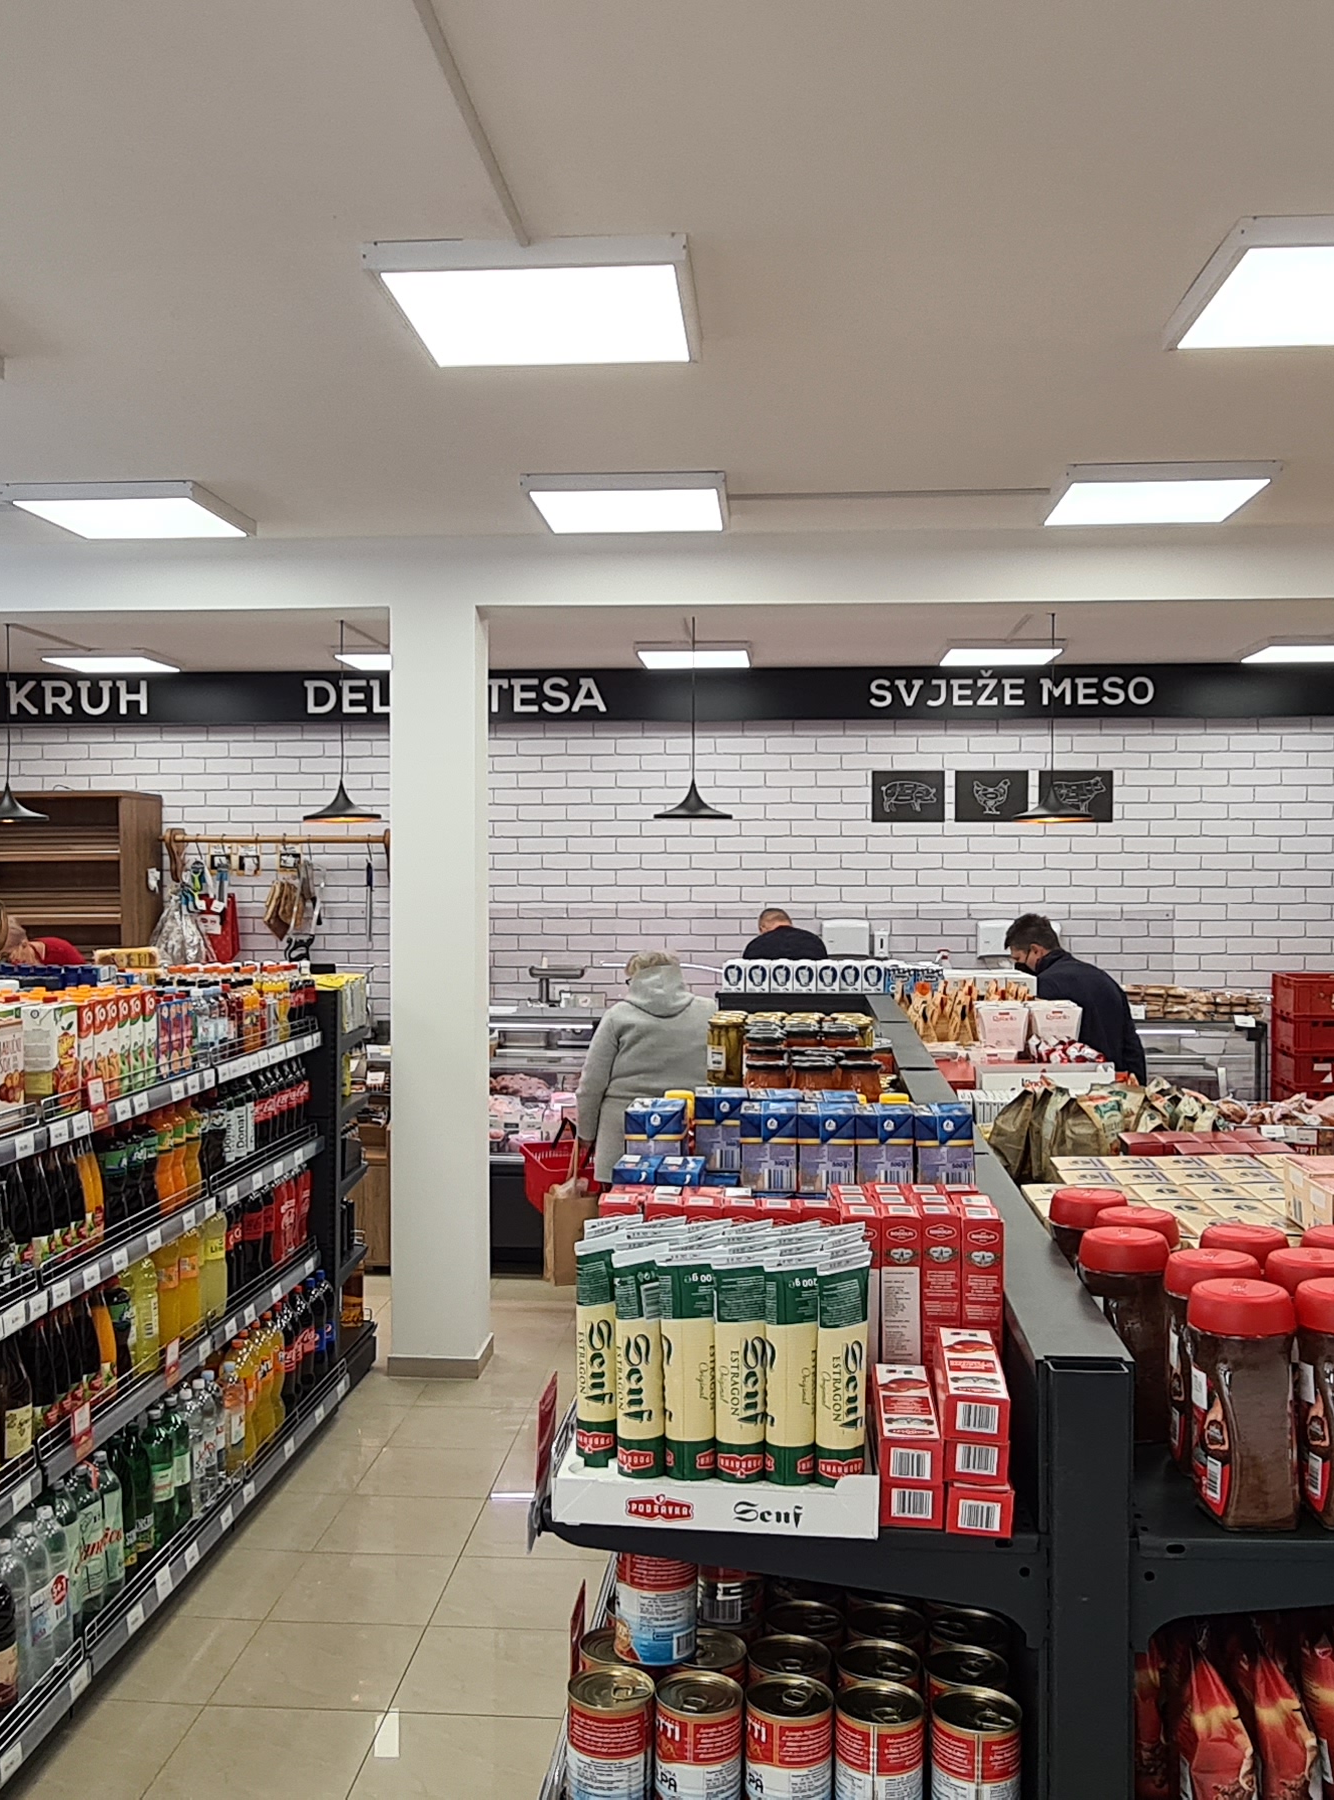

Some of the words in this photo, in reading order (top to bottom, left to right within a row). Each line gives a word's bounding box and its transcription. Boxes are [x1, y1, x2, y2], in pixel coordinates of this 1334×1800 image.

[6, 680, 148, 716] KRUH
[303, 677, 607, 714] DELTESA
[869, 669, 1025, 708] SVJEŽE
[1039, 676, 1155, 706] MESO
[236, 1114, 245, 1149] Donat
[699, 1273, 713, 1282] 00
[577, 1331, 587, 1395] ESTRAGON
[616, 1345, 625, 1411] ESTRAGON
[730, 1350, 740, 1417] ESTRAGON
[832, 1356, 842, 1422] ESTRAGON
[629, 1503, 690, 1517] PODRAVKA
[733, 1500, 803, 1528] Senf
